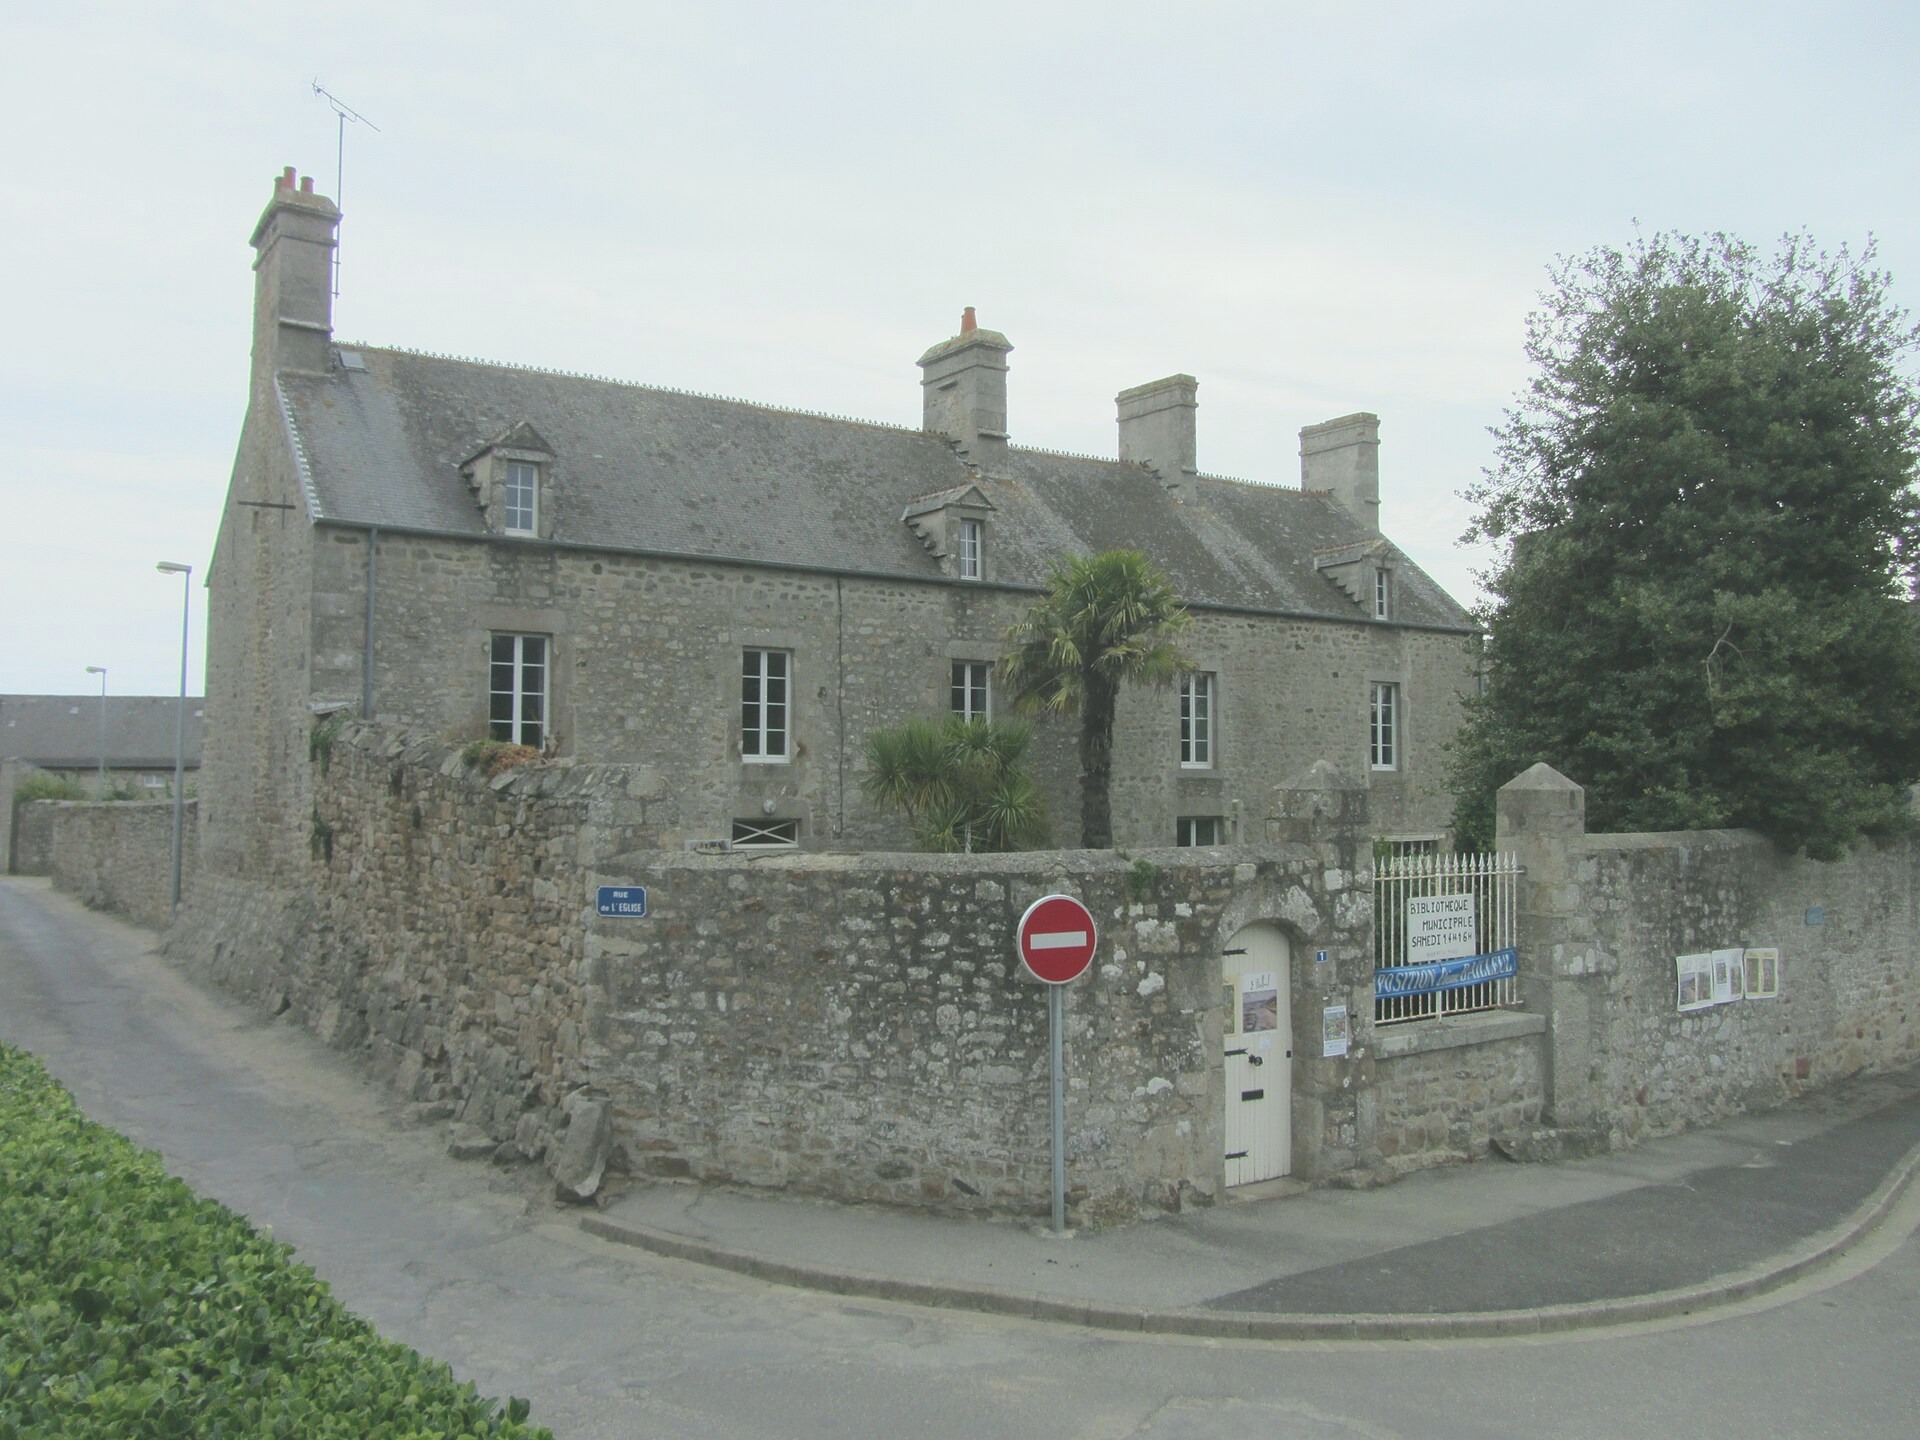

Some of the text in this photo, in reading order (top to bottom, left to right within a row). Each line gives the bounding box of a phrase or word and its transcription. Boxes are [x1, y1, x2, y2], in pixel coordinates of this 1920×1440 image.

[611, 903, 641, 912] L'EGLISE
[1410, 900, 1468, 914] BIBLIOTHEQUE
[1422, 916, 1473, 931] MUNICIPALE
[1412, 934, 1441, 947] SAMEDI
